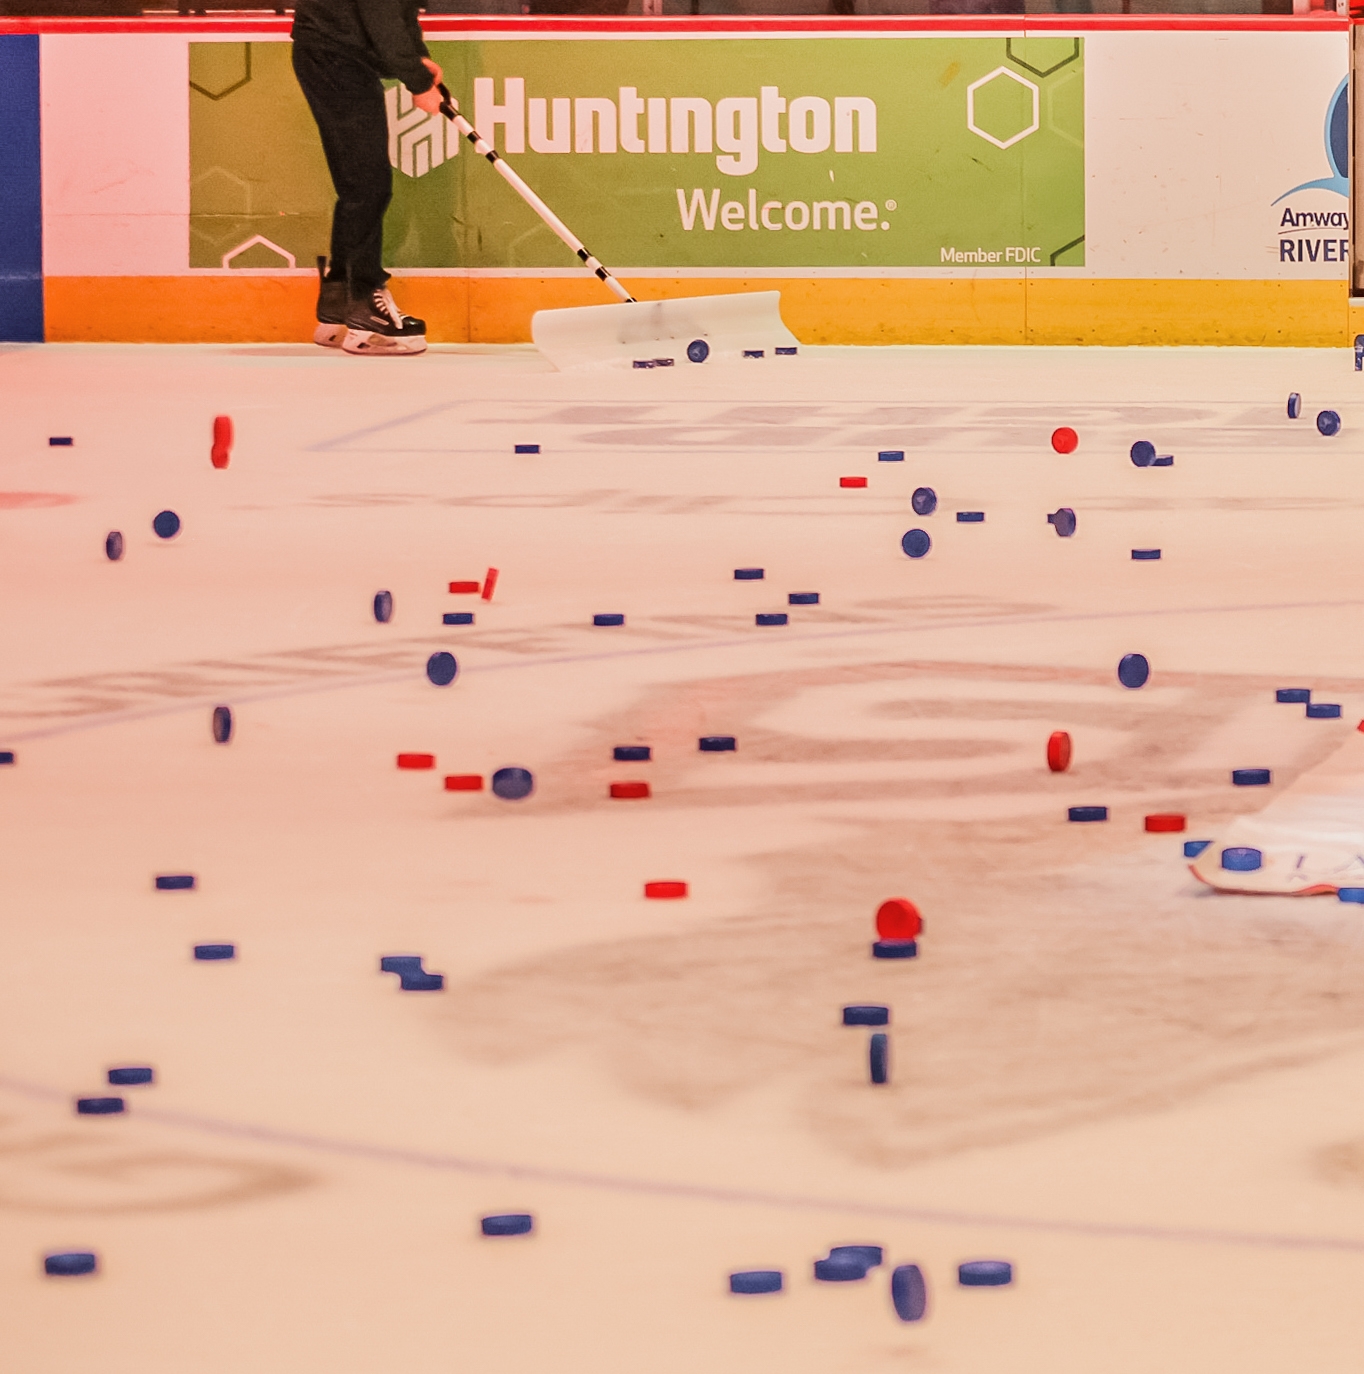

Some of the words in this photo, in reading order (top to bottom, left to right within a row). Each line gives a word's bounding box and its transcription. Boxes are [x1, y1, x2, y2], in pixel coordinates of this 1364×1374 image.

[475, 77, 878, 177] Huntington
[939, 246, 1003, 264] Member
[1005, 246, 1041, 264] FDIC
